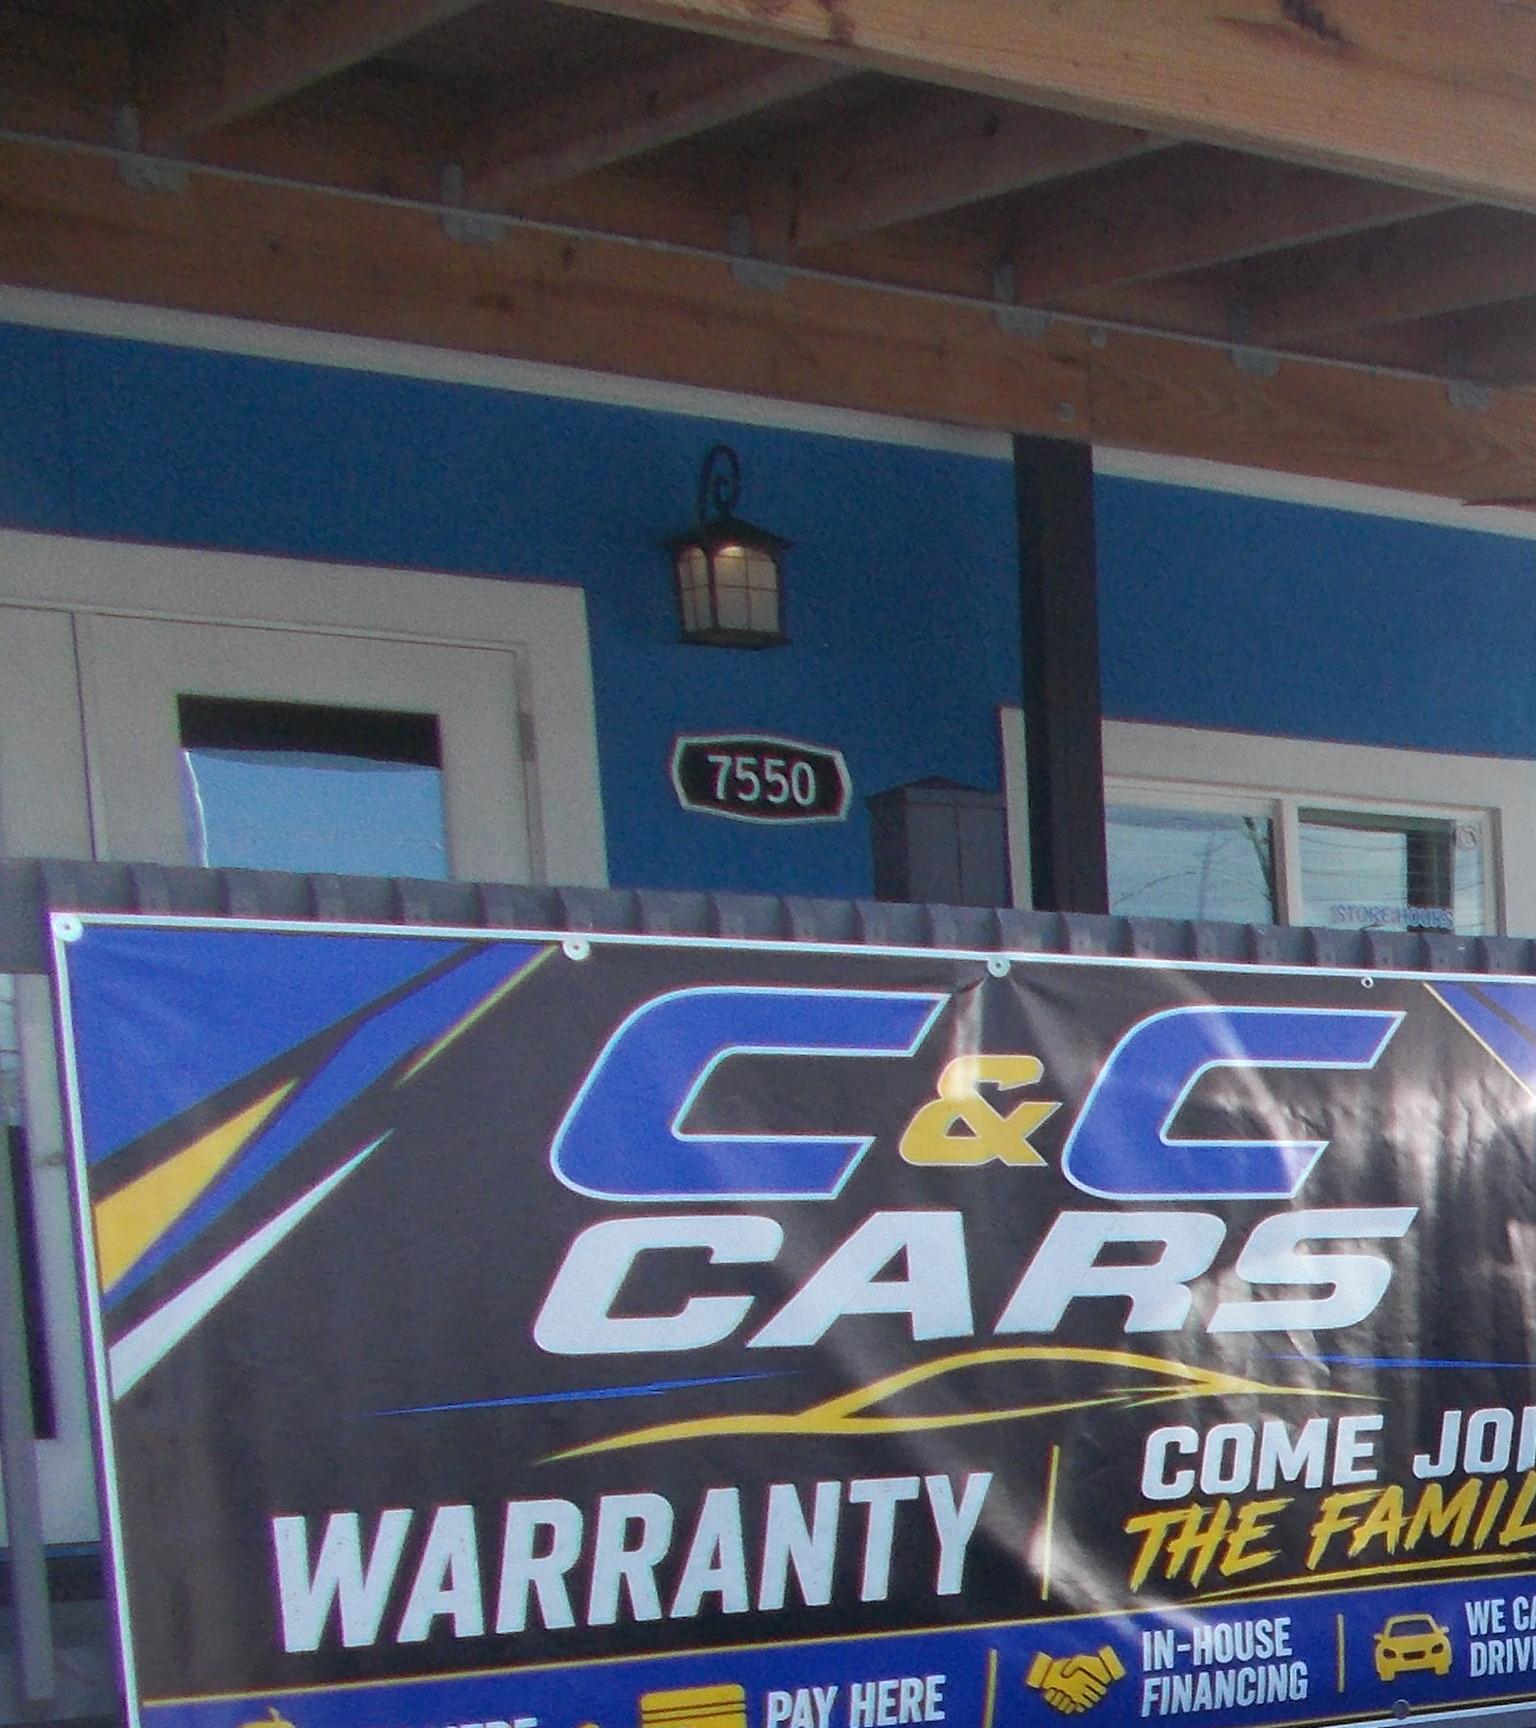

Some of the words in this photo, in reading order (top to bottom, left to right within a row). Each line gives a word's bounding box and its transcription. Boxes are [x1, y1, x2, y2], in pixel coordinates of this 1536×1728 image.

[707, 755, 817, 806] 7550
[533, 1206, 1419, 1356] CARS
[1140, 1414, 1384, 1501] COME
[271, 1471, 993, 1655] WARRANTY
[1124, 1496, 1297, 1593] THE
[1142, 1617, 1293, 1666] IN-HOUSE
[1465, 1600, 1509, 1637] WE
[1141, 1661, 1308, 1718] FINANCING
